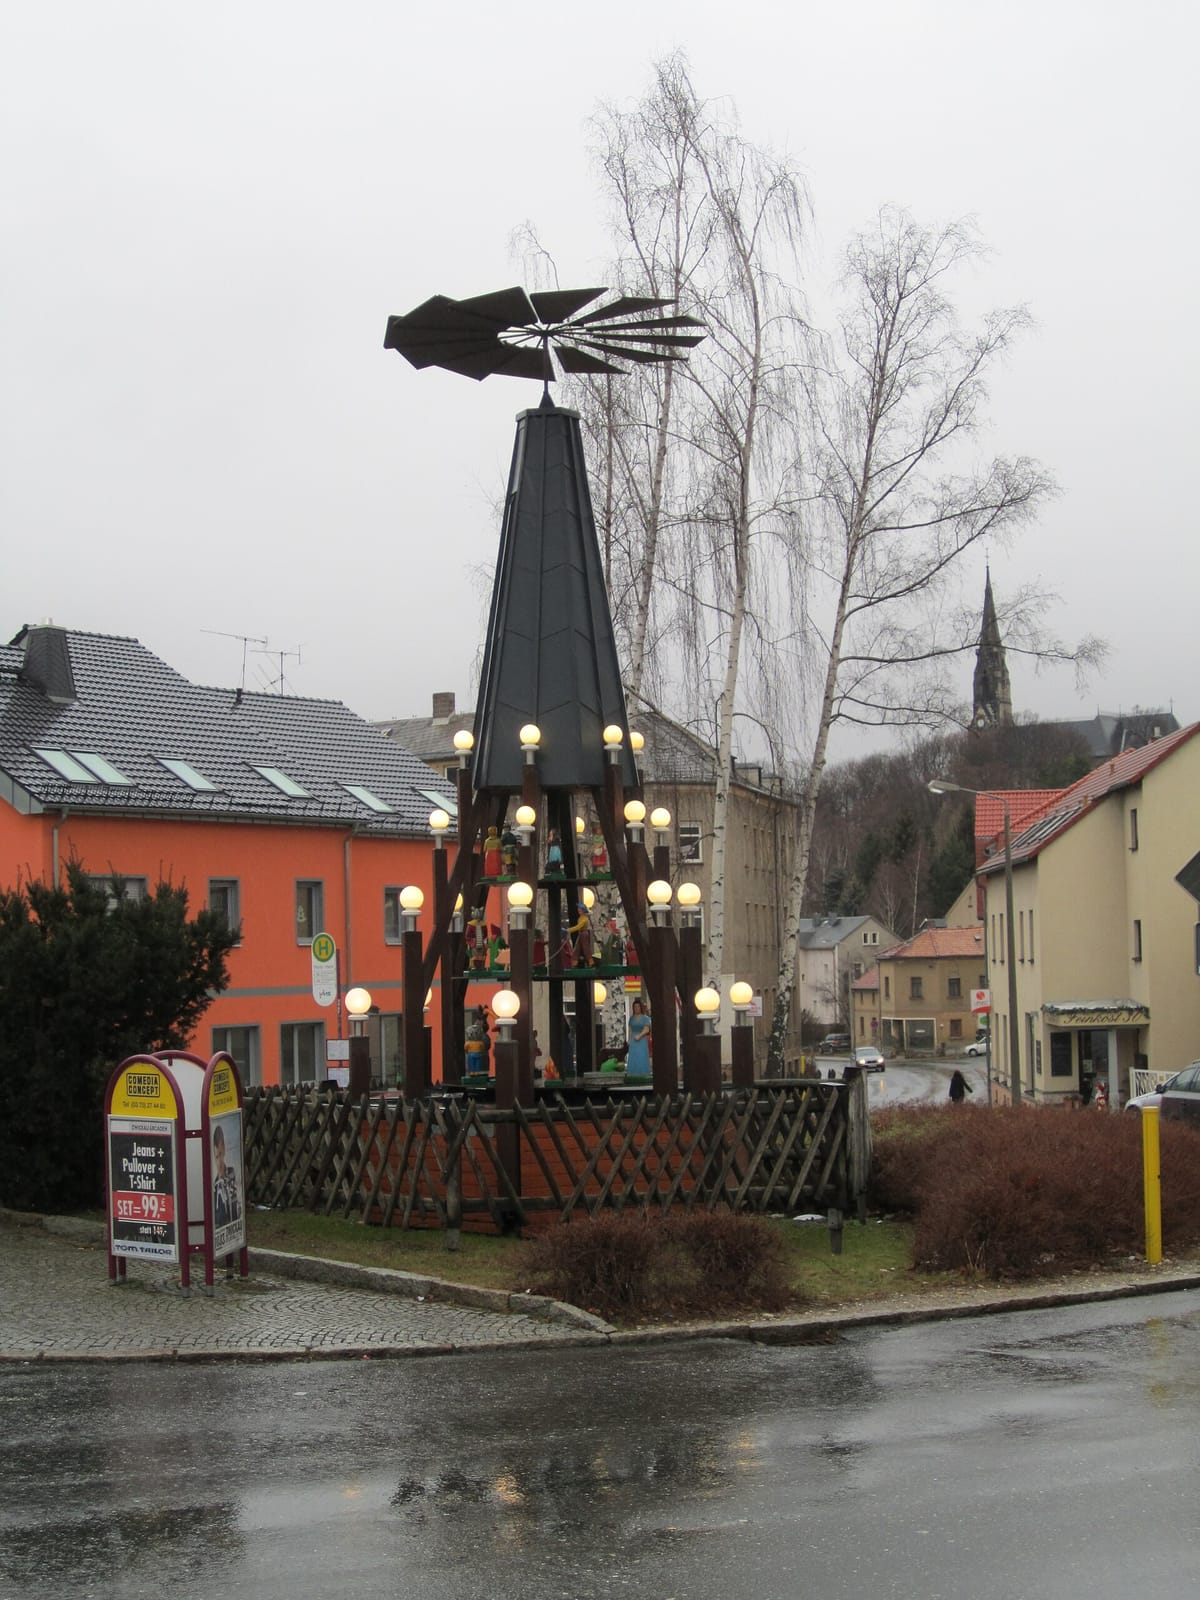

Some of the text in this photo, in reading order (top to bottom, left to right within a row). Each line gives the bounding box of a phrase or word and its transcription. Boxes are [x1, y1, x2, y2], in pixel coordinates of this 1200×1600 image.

[128, 1075, 159, 1085] COMEDIA
[128, 1085, 159, 1095] CONCEPT
[132, 1142, 155, 1157] Jeans
[122, 1158, 156, 1176] Pullover
[129, 1174, 156, 1190] T-Shirt
[117, 1199, 133, 1216] SET
[115, 1244, 172, 1255] TOM TAILOR
